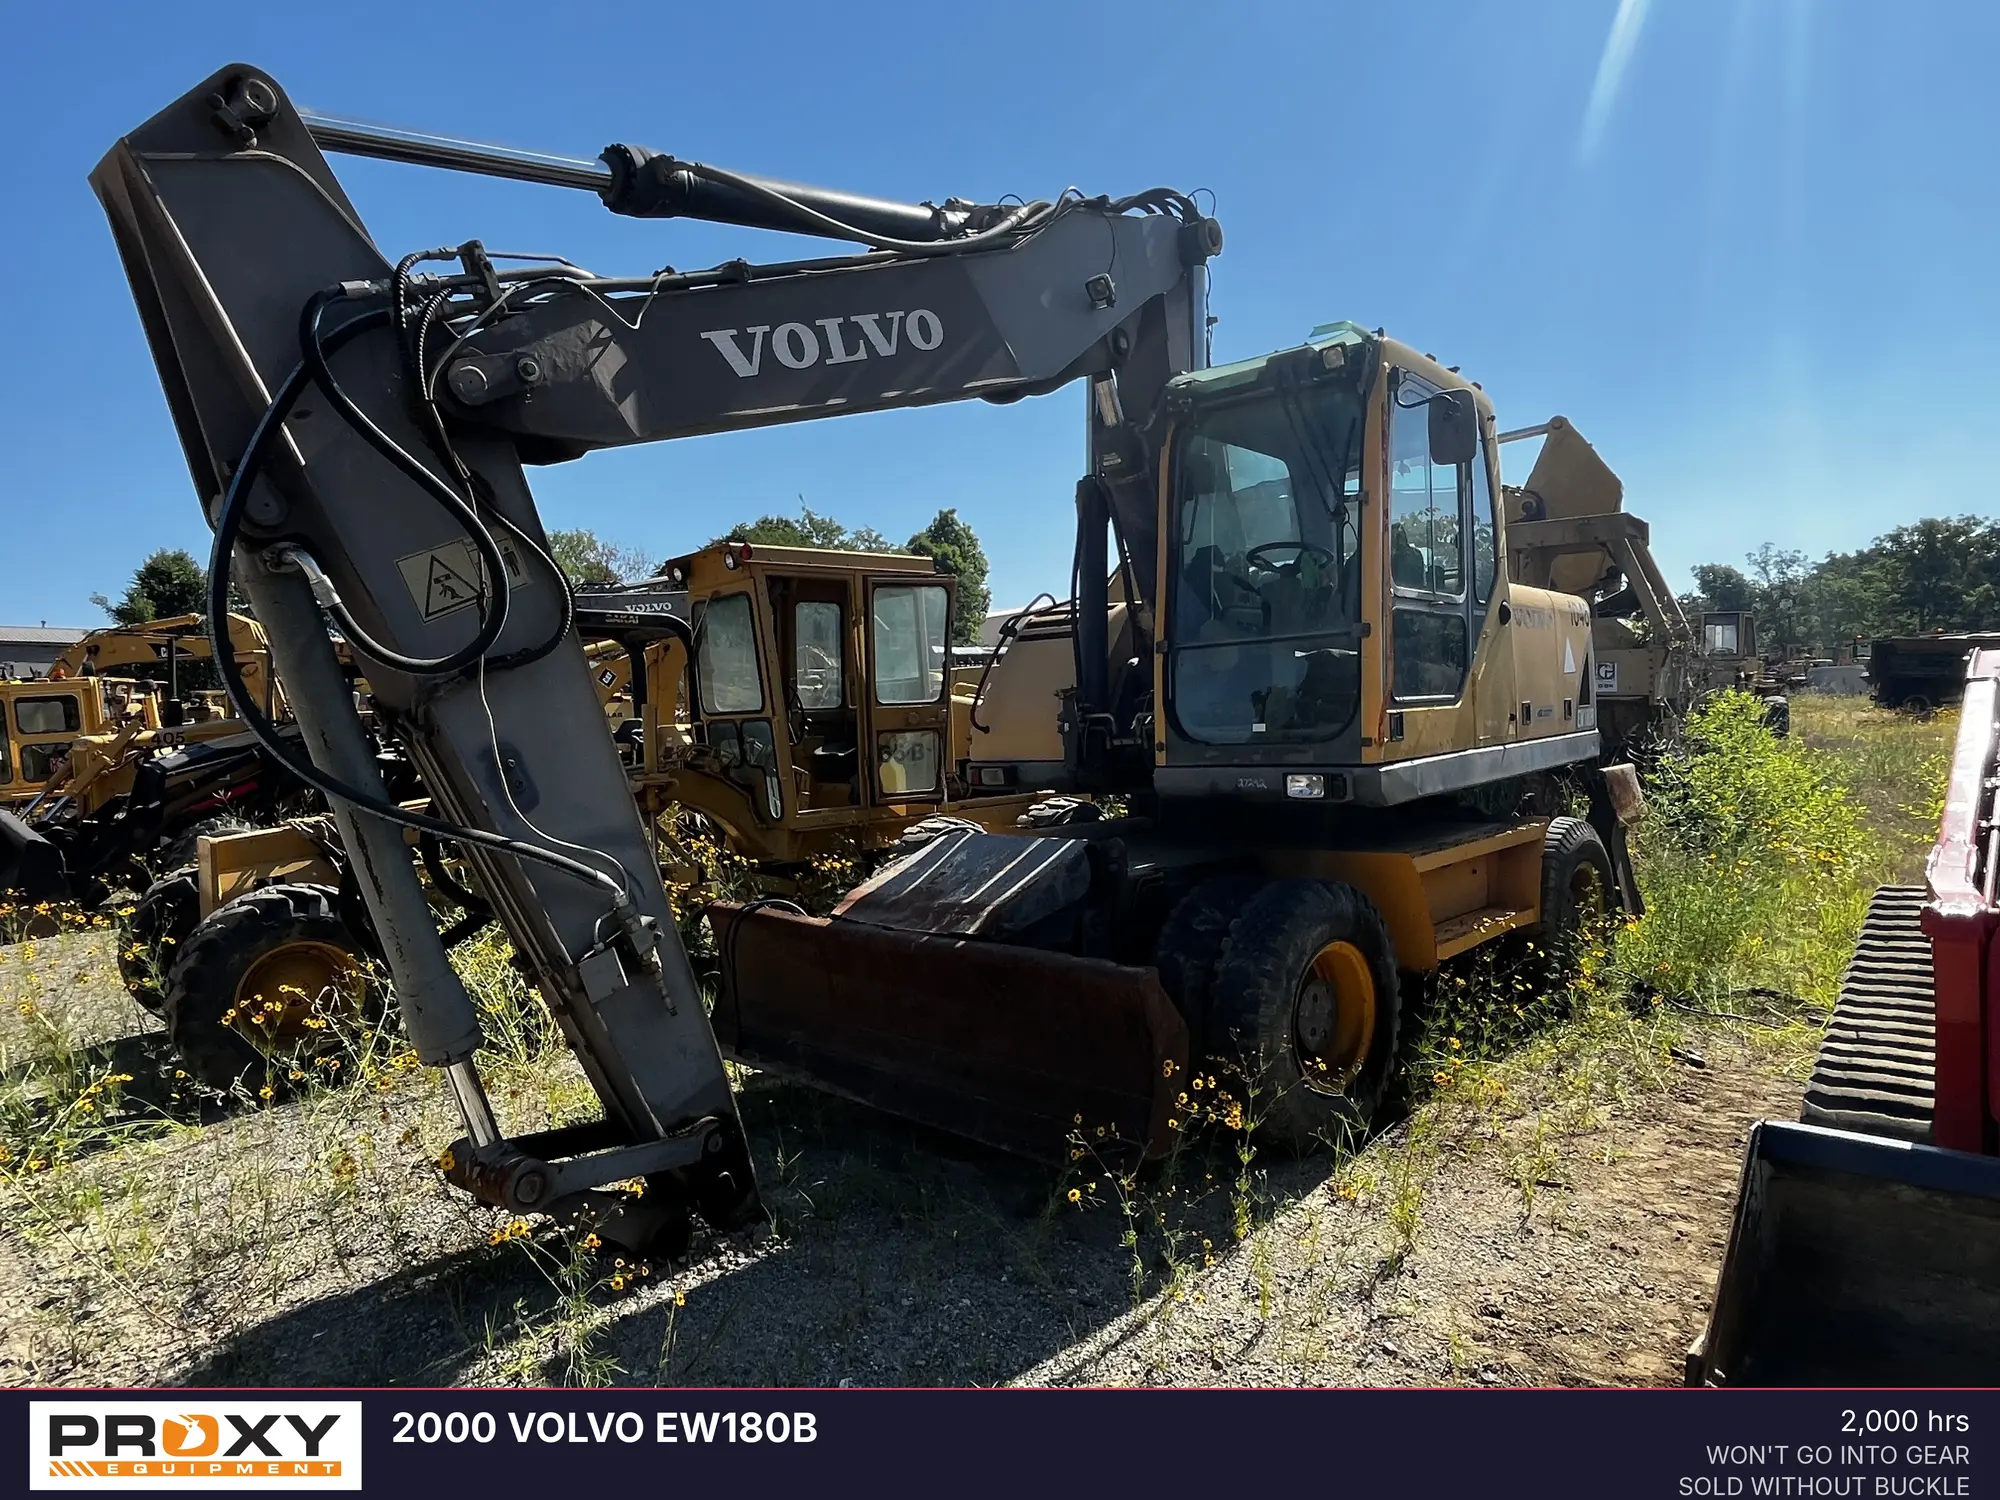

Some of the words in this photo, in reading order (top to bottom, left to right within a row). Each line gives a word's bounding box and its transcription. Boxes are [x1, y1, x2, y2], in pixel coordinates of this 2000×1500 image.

[700, 309, 944, 378] VOLVO
[624, 602, 672, 613] VOLVO
[152, 731, 186, 745] 405
